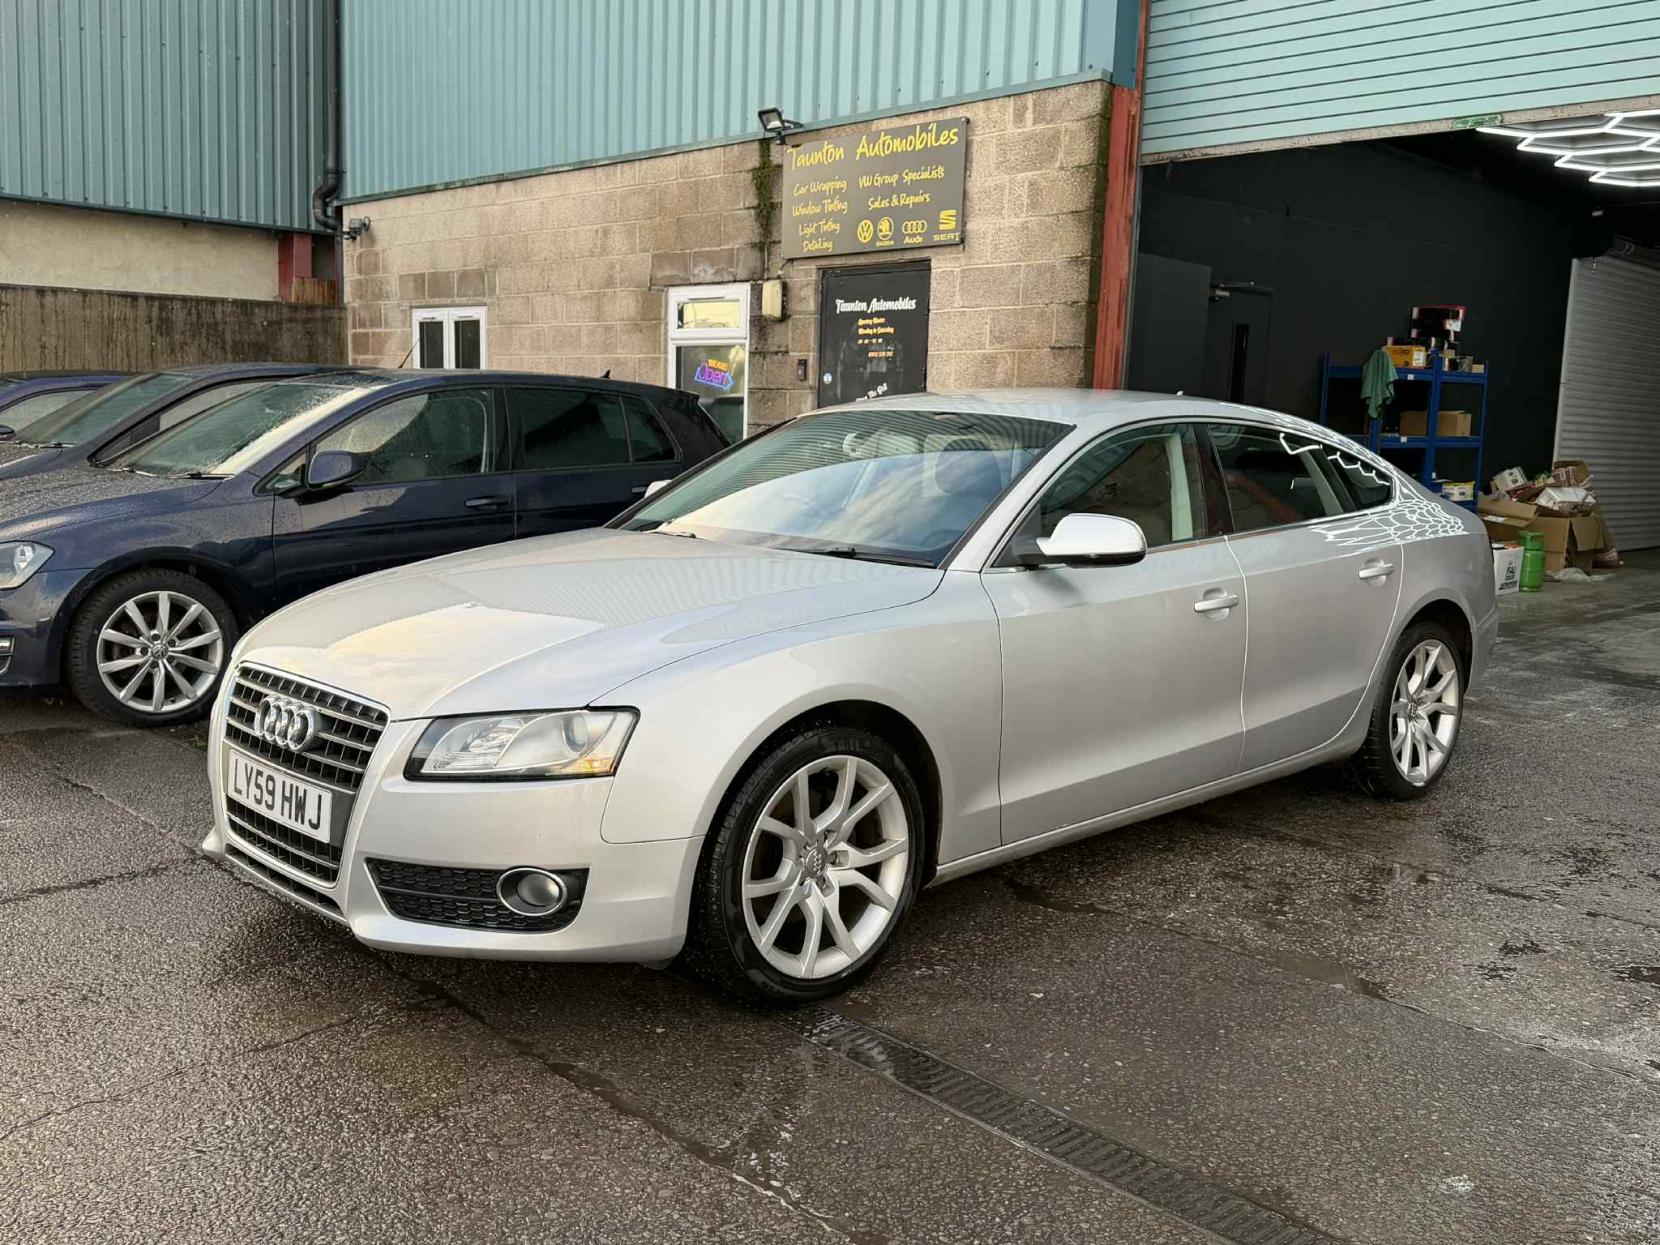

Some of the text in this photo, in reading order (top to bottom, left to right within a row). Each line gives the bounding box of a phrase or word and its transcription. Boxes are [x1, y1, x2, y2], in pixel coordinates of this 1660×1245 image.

[787, 123, 959, 170] Taunton Automobiles
[794, 176, 848, 197] Car Wrapping
[859, 165, 944, 188] VW Group Specialists
[792, 201, 821, 217] Window
[867, 190, 930, 210] Sales & Repairs
[799, 221, 817, 238] Light
[903, 235, 924, 244] Audi
[835, 296, 917, 314] Taunton Automobiles
[234, 758, 322, 830] LY59 HWJ
